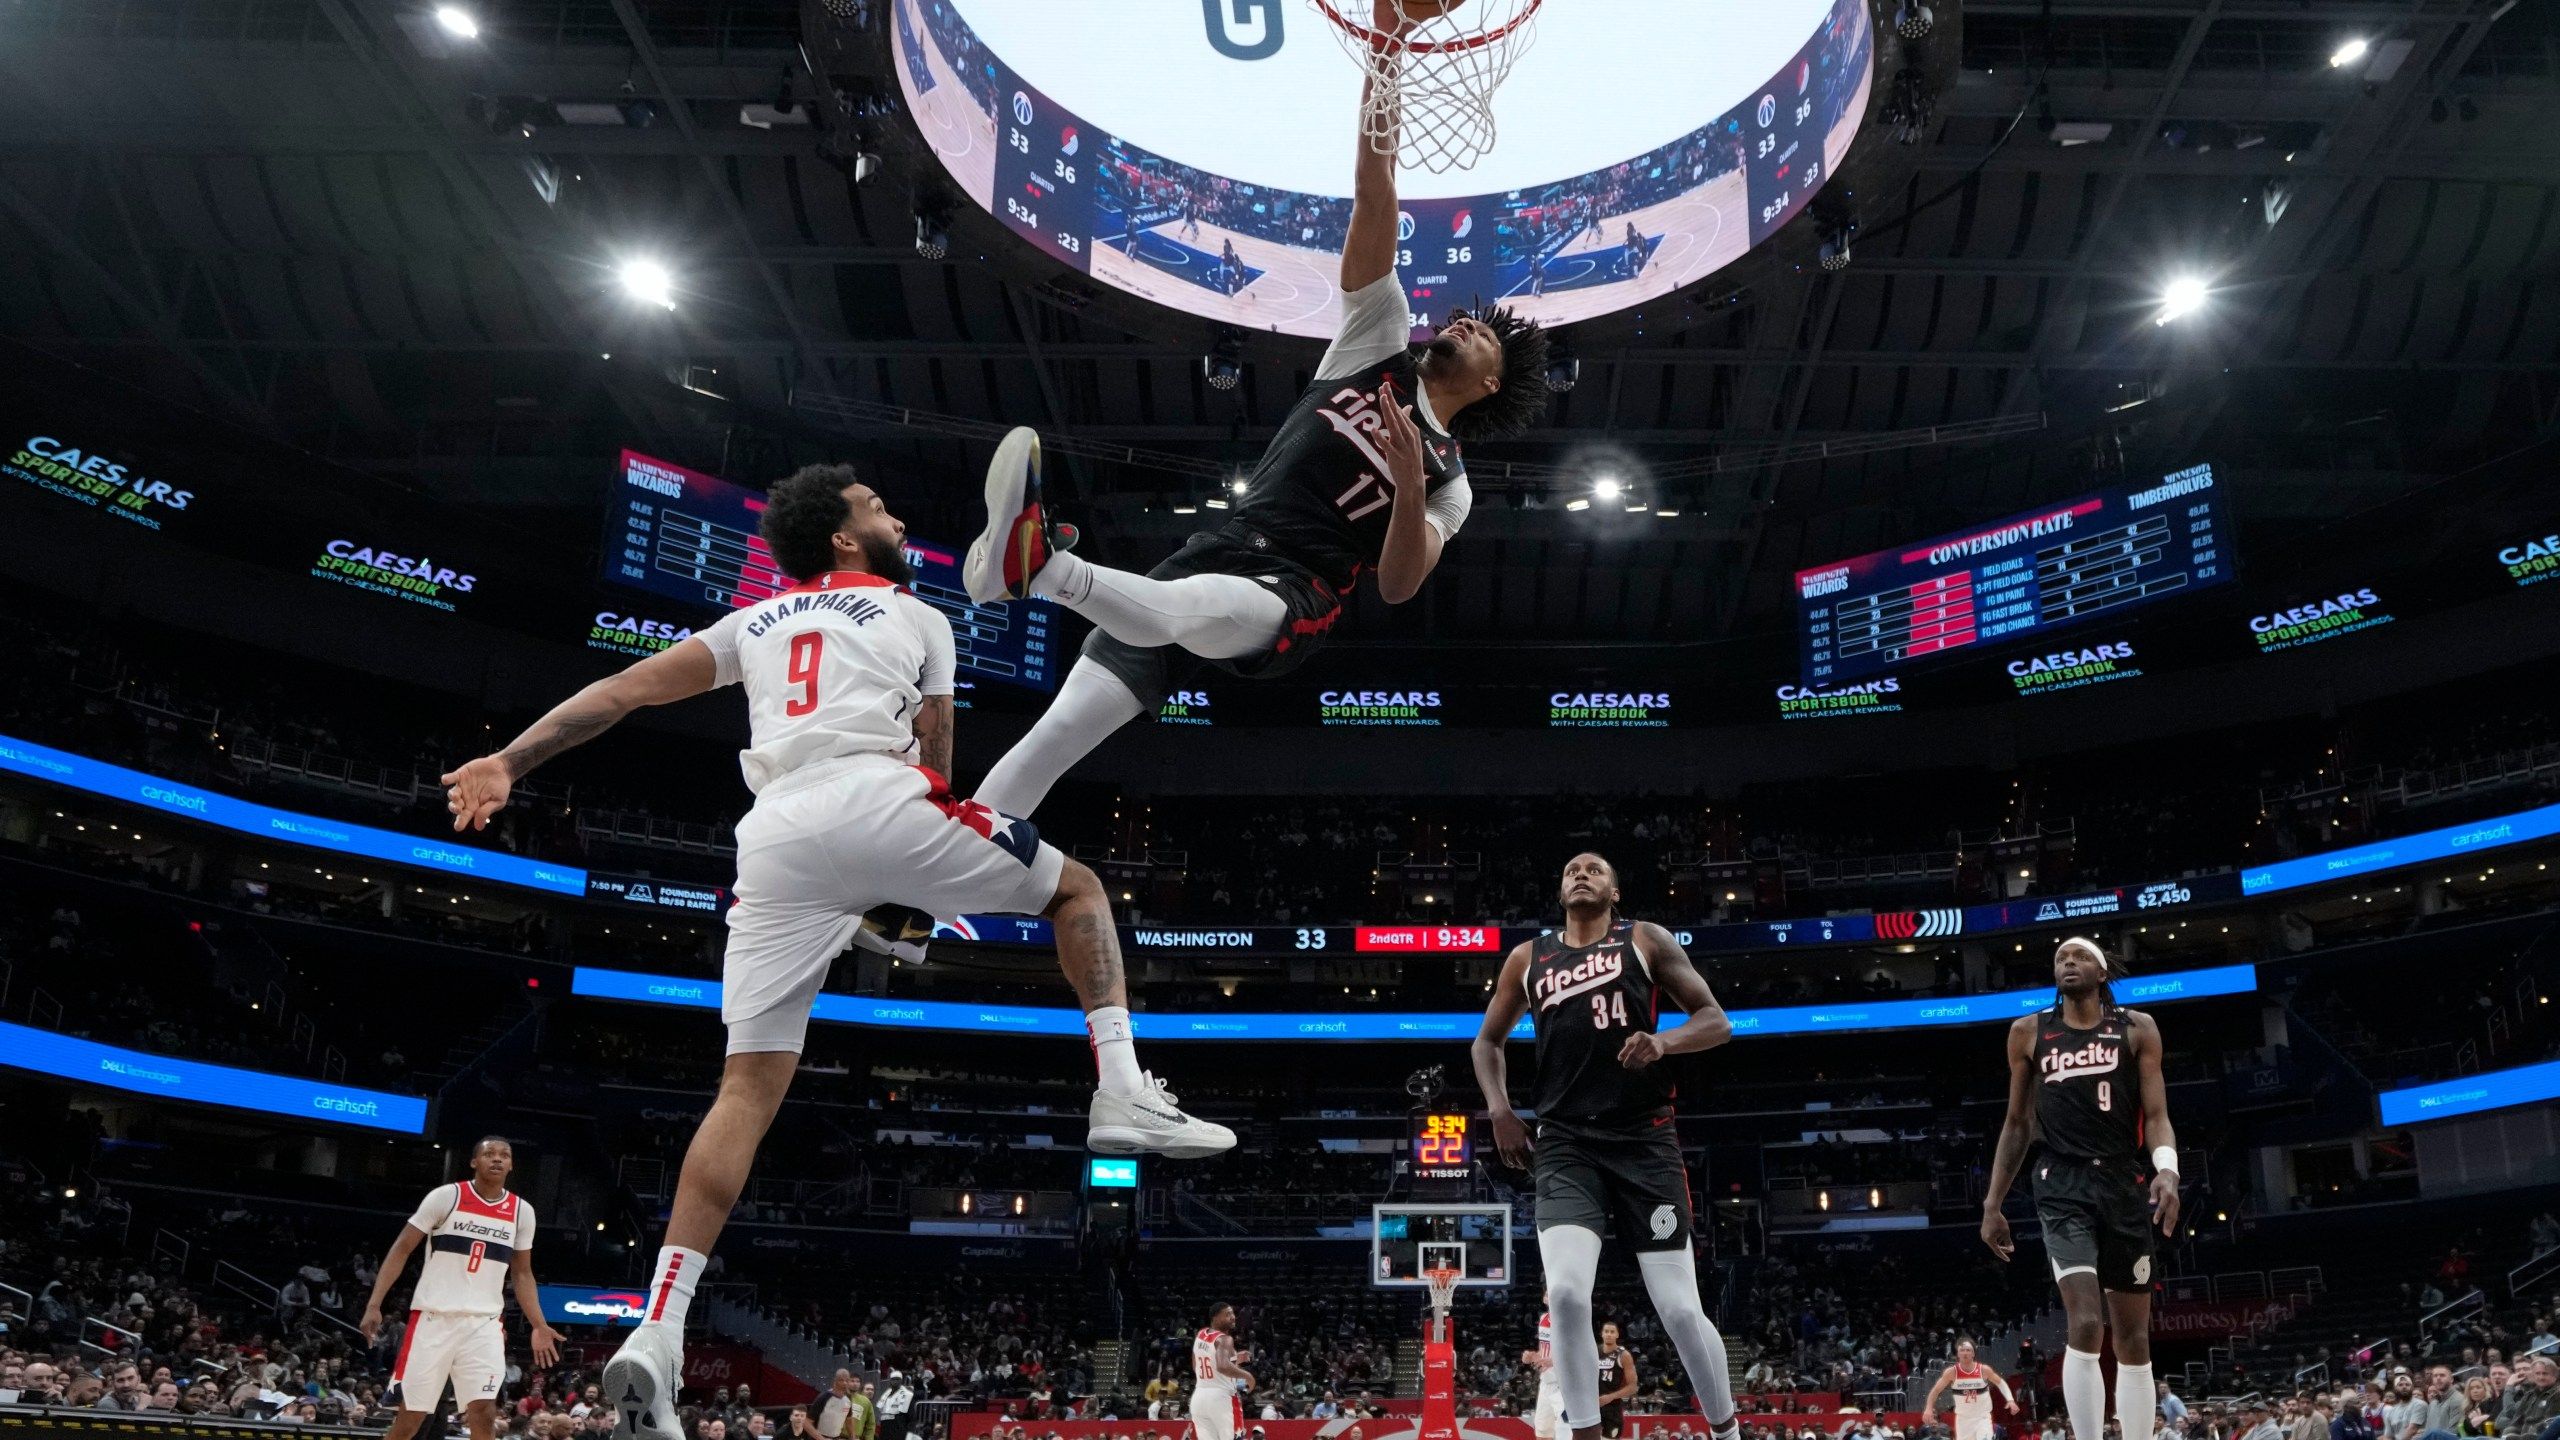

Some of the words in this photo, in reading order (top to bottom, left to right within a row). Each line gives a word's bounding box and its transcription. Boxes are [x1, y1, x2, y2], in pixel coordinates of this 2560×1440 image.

[1795, 97, 1811, 127] 36
[1010, 127, 1029, 154] 33
[1758, 133, 1775, 159] 33
[1055, 158, 1076, 184] 36
[1804, 161, 1819, 188] :23
[1030, 171, 1055, 194] QUARTER
[1008, 197, 1038, 230] 9:34
[1763, 191, 1789, 223] 9:34
[1058, 232, 1079, 252] :23
[1446, 246, 1472, 264] 36
[1417, 275, 1448, 285] QUARTER
[629, 458, 686, 484] WASHINGTON
[2164, 463, 2211, 484] MINNESOTA
[627, 467, 681, 499] WIZARDS
[2128, 472, 2213, 511] TIMBERWOLVES
[1335, 472, 1391, 522] 17
[1929, 524, 2030, 565] CONVERSION
[2031, 510, 2073, 538] RATE
[2128, 525, 2138, 537] 42
[2123, 542, 2133, 553] 23
[326, 539, 478, 592] CAESARS
[1983, 565, 2000, 577] FIELD
[2002, 557, 2024, 571] GOALS
[2058, 561, 2066, 571] 14
[2132, 556, 2141, 566] 15
[311, 568, 343, 582] WITH
[345, 578, 398, 597] CAESARS
[317, 554, 441, 596] SPORTSBOOK
[1803, 567, 1850, 585] WASHINGTON
[1976, 581, 1992, 594] 3-PT
[1994, 577, 2010, 589] FIELD
[2012, 570, 2034, 584] GOALS
[2071, 573, 2080, 584] 24
[2113, 577, 2119, 588] 4
[1802, 576, 1848, 599] WIZARDS
[1987, 595, 1996, 606] FG
[1996, 593, 2005, 604] IN
[2005, 587, 2026, 601] PAINT
[2140, 586, 2146, 596] 7
[747, 593, 886, 638] CHAMPAGNIE
[1872, 610, 1881, 620] 23
[1939, 608, 1946, 618] 21
[1982, 611, 1992, 622] FG
[1993, 607, 2008, 620] FAST
[2010, 601, 2033, 615] BREAK
[2250, 588, 2380, 633] CAESARS
[1871, 624, 1880, 635] 25
[1940, 623, 1945, 633] 7
[1992, 622, 2007, 635] 2ND
[2008, 615, 2036, 631] CHANCE
[2255, 609, 2364, 644] SPORTSBOOK
[586, 640, 617, 652] WITH
[1812, 636, 1830, 648] 45.7%
[2261, 642, 2291, 653] WITH
[2293, 629, 2342, 645] CAESARS
[1894, 650, 1899, 659] 2
[2007, 641, 2135, 677] CAESARS
[786, 630, 824, 717] 9
[2013, 660, 2116, 688] SPORTSBOOK
[2019, 687, 2045, 696] WITH
[2047, 678, 2091, 692] CAESARS
[2094, 669, 2143, 682] REWARDS
[1320, 691, 1441, 707] CAESARS
[1550, 693, 1670, 708] CAESARS
[1780, 694, 1879, 711] SPORTSBOOK
[1321, 707, 1419, 717] SPORTSBOOK
[1550, 708, 1648, 719] SPORTSBOOK
[1783, 712, 1807, 720] WITH
[1810, 708, 1852, 718] CAESARS
[1855, 704, 1903, 714] REWARDS
[141, 785, 207, 813] carahsoft
[2452, 824, 2512, 847] carahsoft
[412, 847, 474, 868] carahsoft
[591, 881, 610, 891] 7:50
[611, 882, 625, 892] PM
[660, 887, 717, 901] FOUNDATION
[2144, 883, 2177, 894] JACKPOT
[658, 897, 685, 907] 50/50
[686, 901, 716, 911] RAFFLE
[2065, 895, 2118, 908] FOUNDATION
[2137, 888, 2191, 909] $2,450
[2066, 906, 2090, 917] 50/50
[2091, 903, 2119, 914] RAFFLE
[1015, 921, 1039, 929] FOULS
[1770, 923, 1792, 931] FOULS
[1022, 930, 1028, 941] 1
[1135, 930, 1253, 947] WASHINGTON
[1295, 929, 1327, 950] 33
[1369, 932, 1414, 945] 2ndQTR
[1437, 929, 1485, 947] 9:34
[1778, 933, 1786, 943] 0
[1824, 929, 1832, 940] 6
[1536, 951, 1622, 1012] ripcity
[2132, 981, 2184, 997] carahsoft
[648, 983, 702, 1000] carahsoft
[873, 1007, 925, 1020] carahsoft
[980, 1014, 999, 1022] DELL
[1591, 991, 1628, 1030] 34
[1920, 1004, 1969, 1017] carahsoft
[1299, 1021, 1347, 1033] carahsoft
[102, 1059, 127, 1074] DELL
[2041, 1042, 2119, 1084] ripcity
[2097, 1081, 2111, 1111] 9
[2420, 1095, 2442, 1108] DELL
[314, 1094, 378, 1117] carahsoft
[1427, 1115, 1465, 1134] 9:34
[1420, 1132, 1462, 1164] 22
[1429, 1169, 1470, 1178] TISSOT
[453, 1220, 511, 1241] wizards
[467, 1240, 486, 1273] 8
[689, 1357, 731, 1380] Lofts
[1198, 1356, 1214, 1380] 36
[1601, 1370, 1613, 1382] 24
[1963, 1389, 1977, 1403] 24
